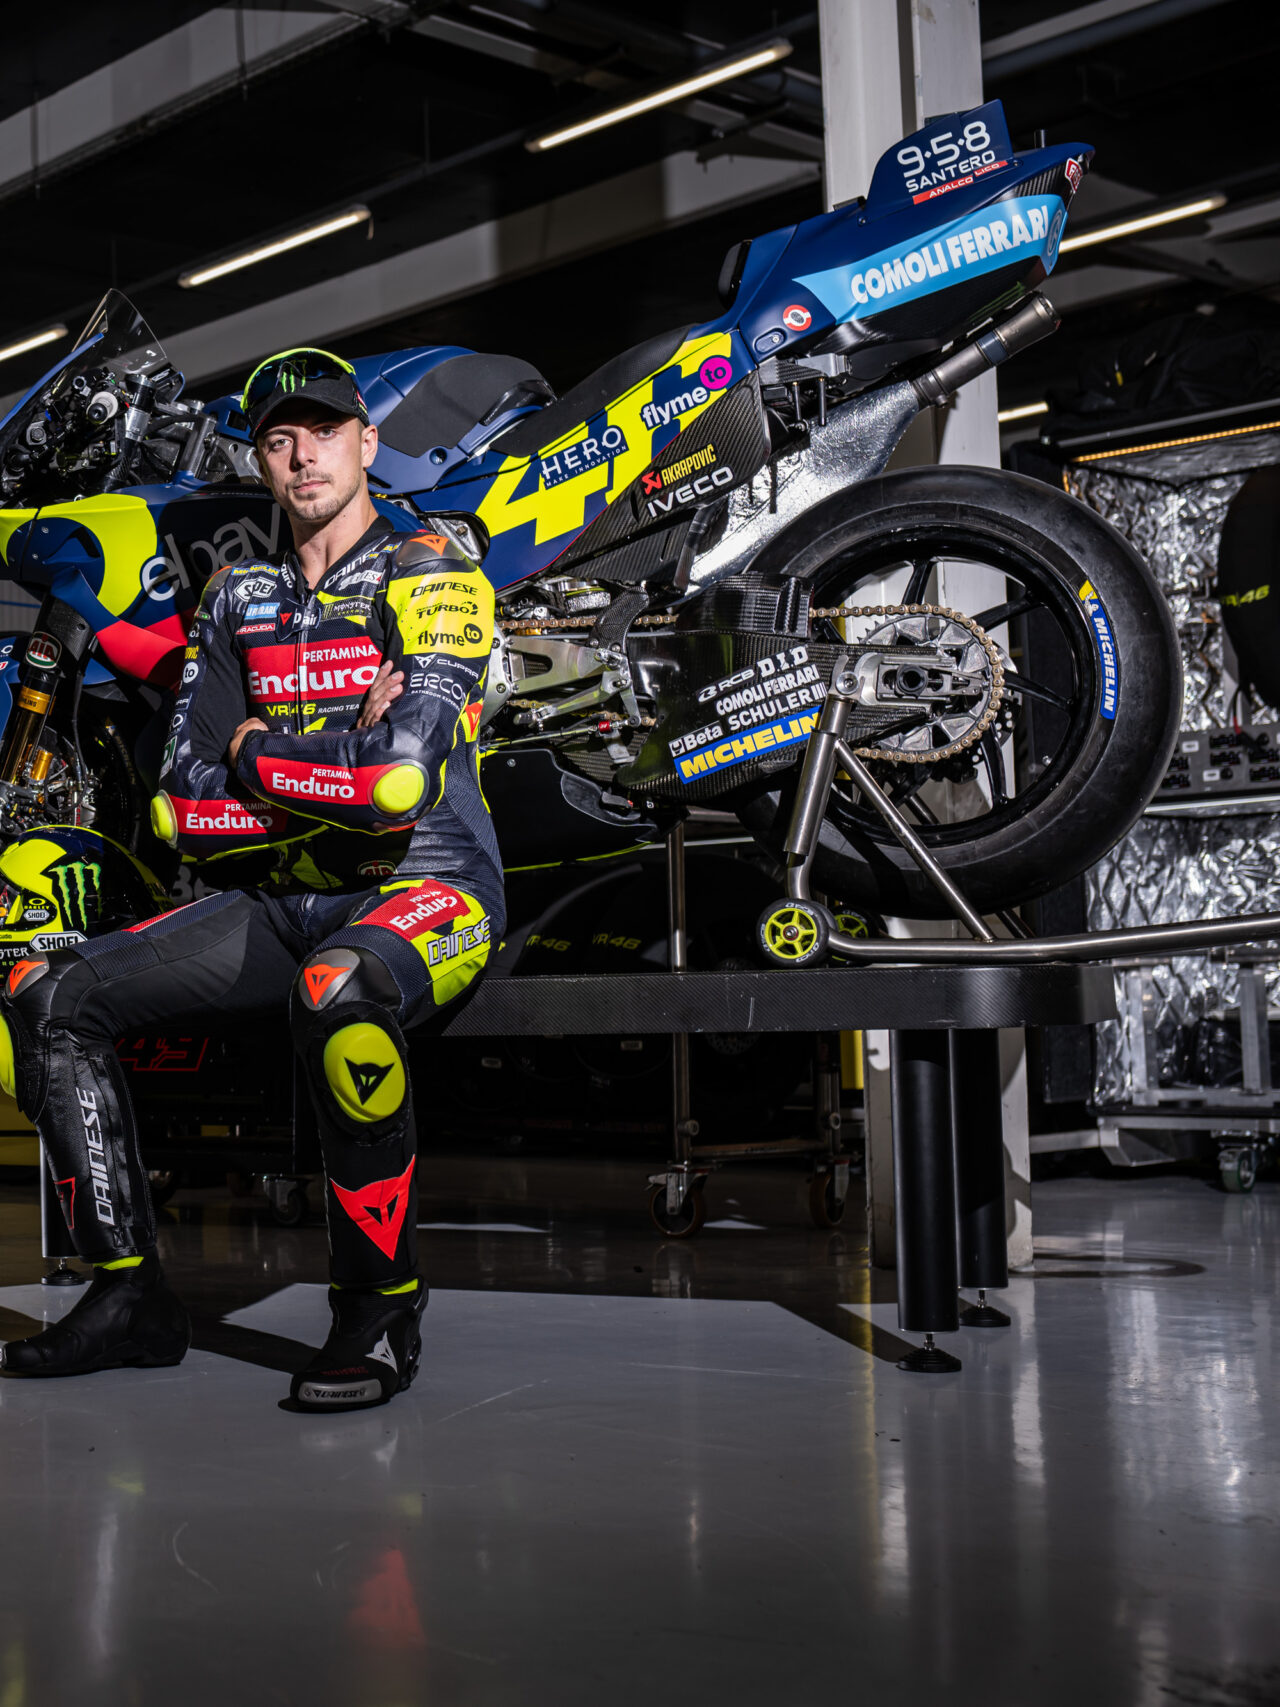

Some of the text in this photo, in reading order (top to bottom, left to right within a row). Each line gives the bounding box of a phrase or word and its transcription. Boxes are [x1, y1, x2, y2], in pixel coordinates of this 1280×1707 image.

[906, 150, 996, 193] SANTERO
[851, 205, 1049, 304] COMOLI FERRARI
[704, 365, 727, 383] to
[642, 386, 708, 428] flyme
[542, 427, 622, 480] HERO
[546, 445, 627, 487] MAKE INNOVATION
[646, 466, 734, 518] IVECO
[140, 503, 280, 602] ebay
[410, 582, 478, 598] DAINESE
[332, 601, 371, 612] MONSTER
[418, 631, 465, 647] flyme
[466, 627, 480, 641] to
[302, 645, 379, 662] PERTAMINA
[1094, 617, 1115, 712] MICHELIN
[184, 667, 196, 679] to
[248, 665, 379, 696] Enduro
[437, 658, 480, 680] CUPRA
[720, 668, 755, 692] RCB
[411, 690, 441, 698] BATHROOM
[716, 664, 820, 716] COMOLI FERRARI
[317, 706, 344, 714] RACING
[684, 689, 813, 751] Beta SCHULER
[680, 712, 820, 779] MICHELIN
[272, 774, 355, 799] Enduro
[225, 803, 271, 812] PERTAMINA
[186, 813, 273, 829] Enduro
[27, 911, 46, 919] SHOEI
[429, 915, 491, 967] DAINESE
[75, 1088, 114, 1226] DAINESE
